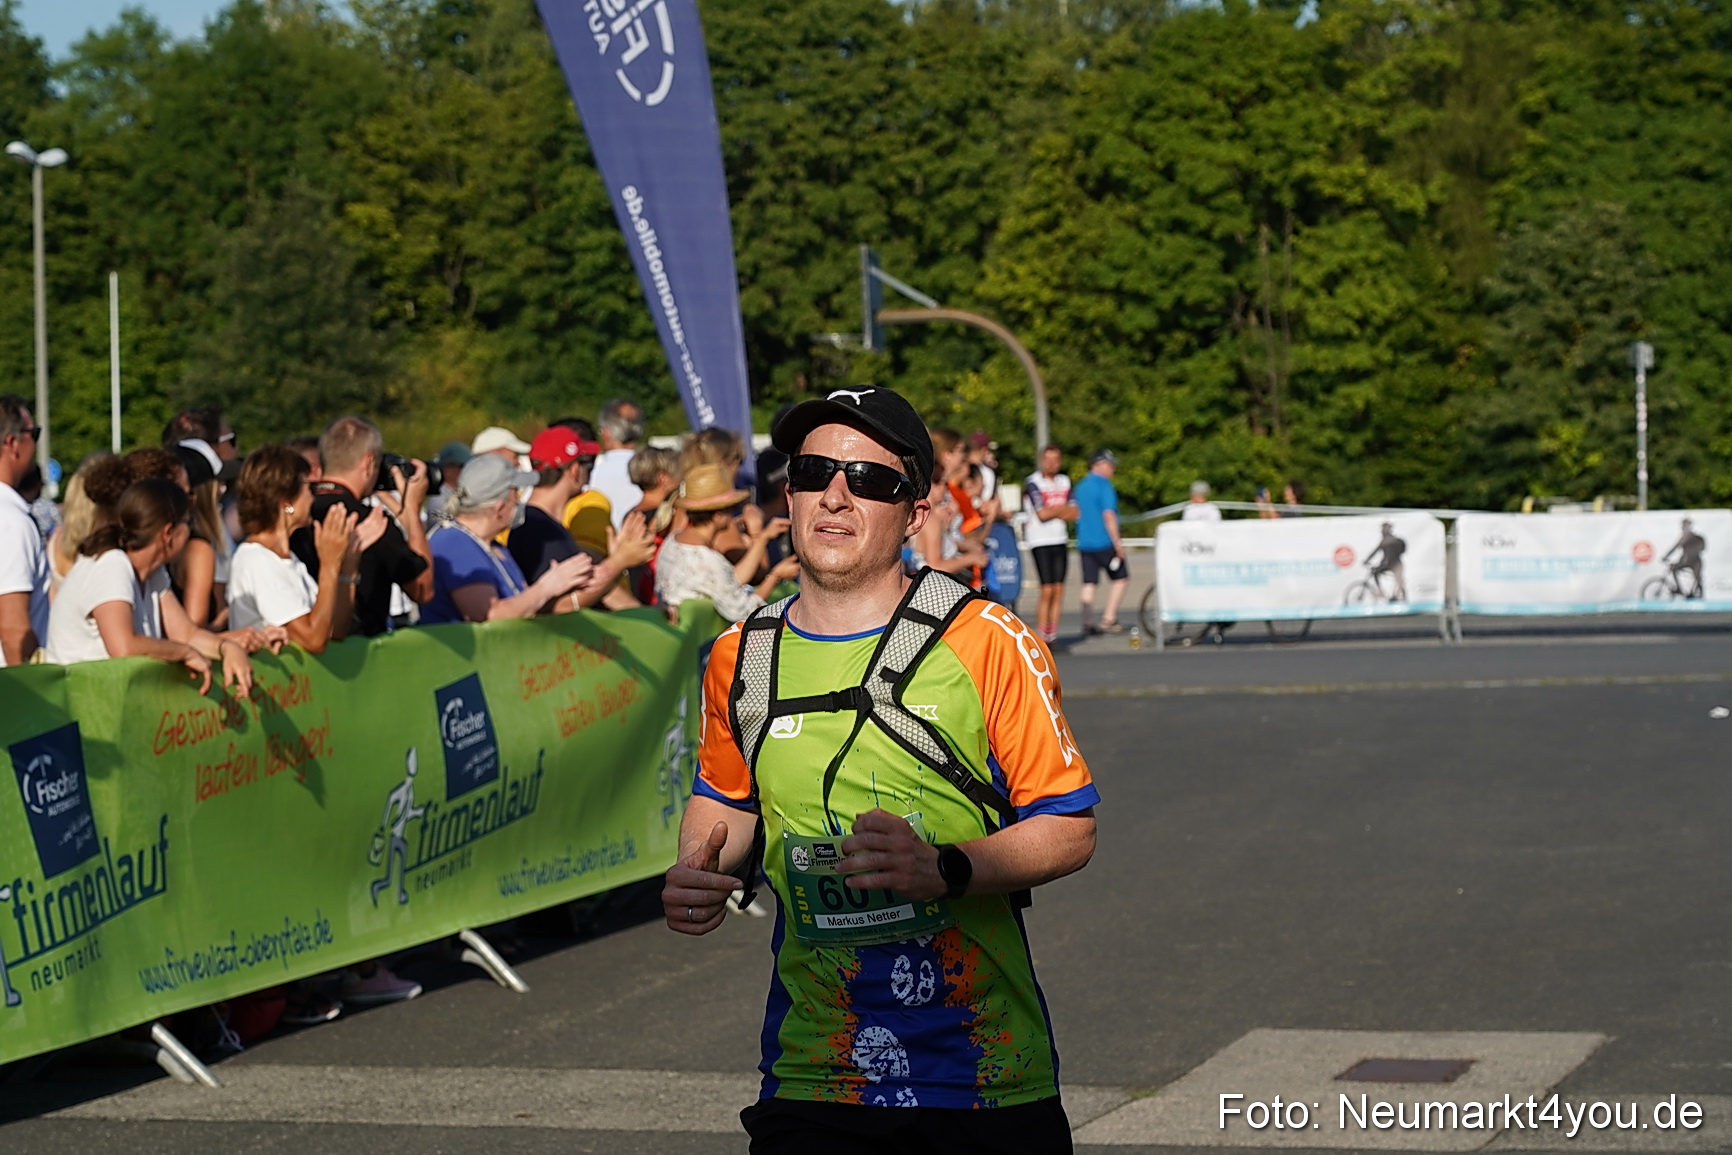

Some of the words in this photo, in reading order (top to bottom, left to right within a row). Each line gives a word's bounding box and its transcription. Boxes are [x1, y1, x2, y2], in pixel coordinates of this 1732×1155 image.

[154, 687, 246, 755] Gesunde
[36, 770, 78, 805] Fischer
[195, 746, 258, 803] laufen
[419, 748, 545, 867] firmenlauf
[12, 814, 169, 957] firmenlauf
[414, 849, 472, 893] neumarkt
[795, 885, 813, 924] RUN
[827, 914, 865, 926] Markus
[866, 910, 901, 922] Netter
[30, 936, 101, 991] neumarkt
